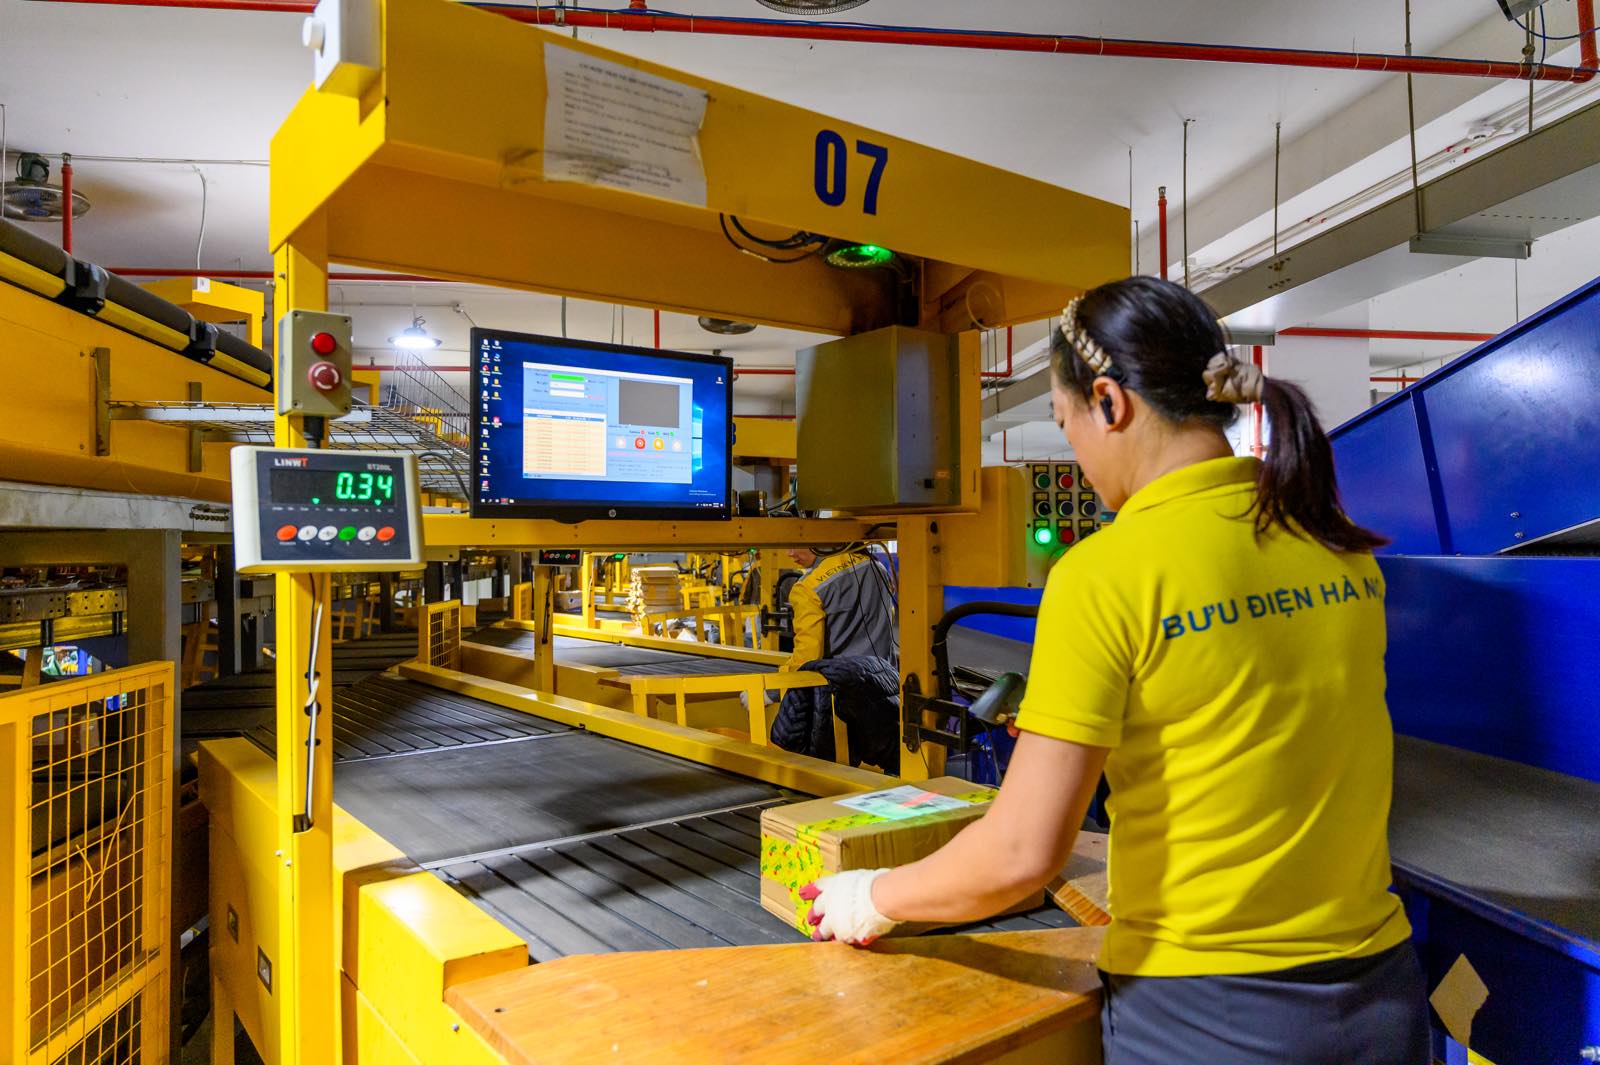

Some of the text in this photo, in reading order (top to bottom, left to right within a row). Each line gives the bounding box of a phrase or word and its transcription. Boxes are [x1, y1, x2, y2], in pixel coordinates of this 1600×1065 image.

[815, 130, 888, 216] 07
[336, 472, 393, 500] 0.34
[1162, 598, 1239, 640] BƯU
[1247, 586, 1313, 618] ĐIỆN
[1319, 575, 1360, 605] HÀ
